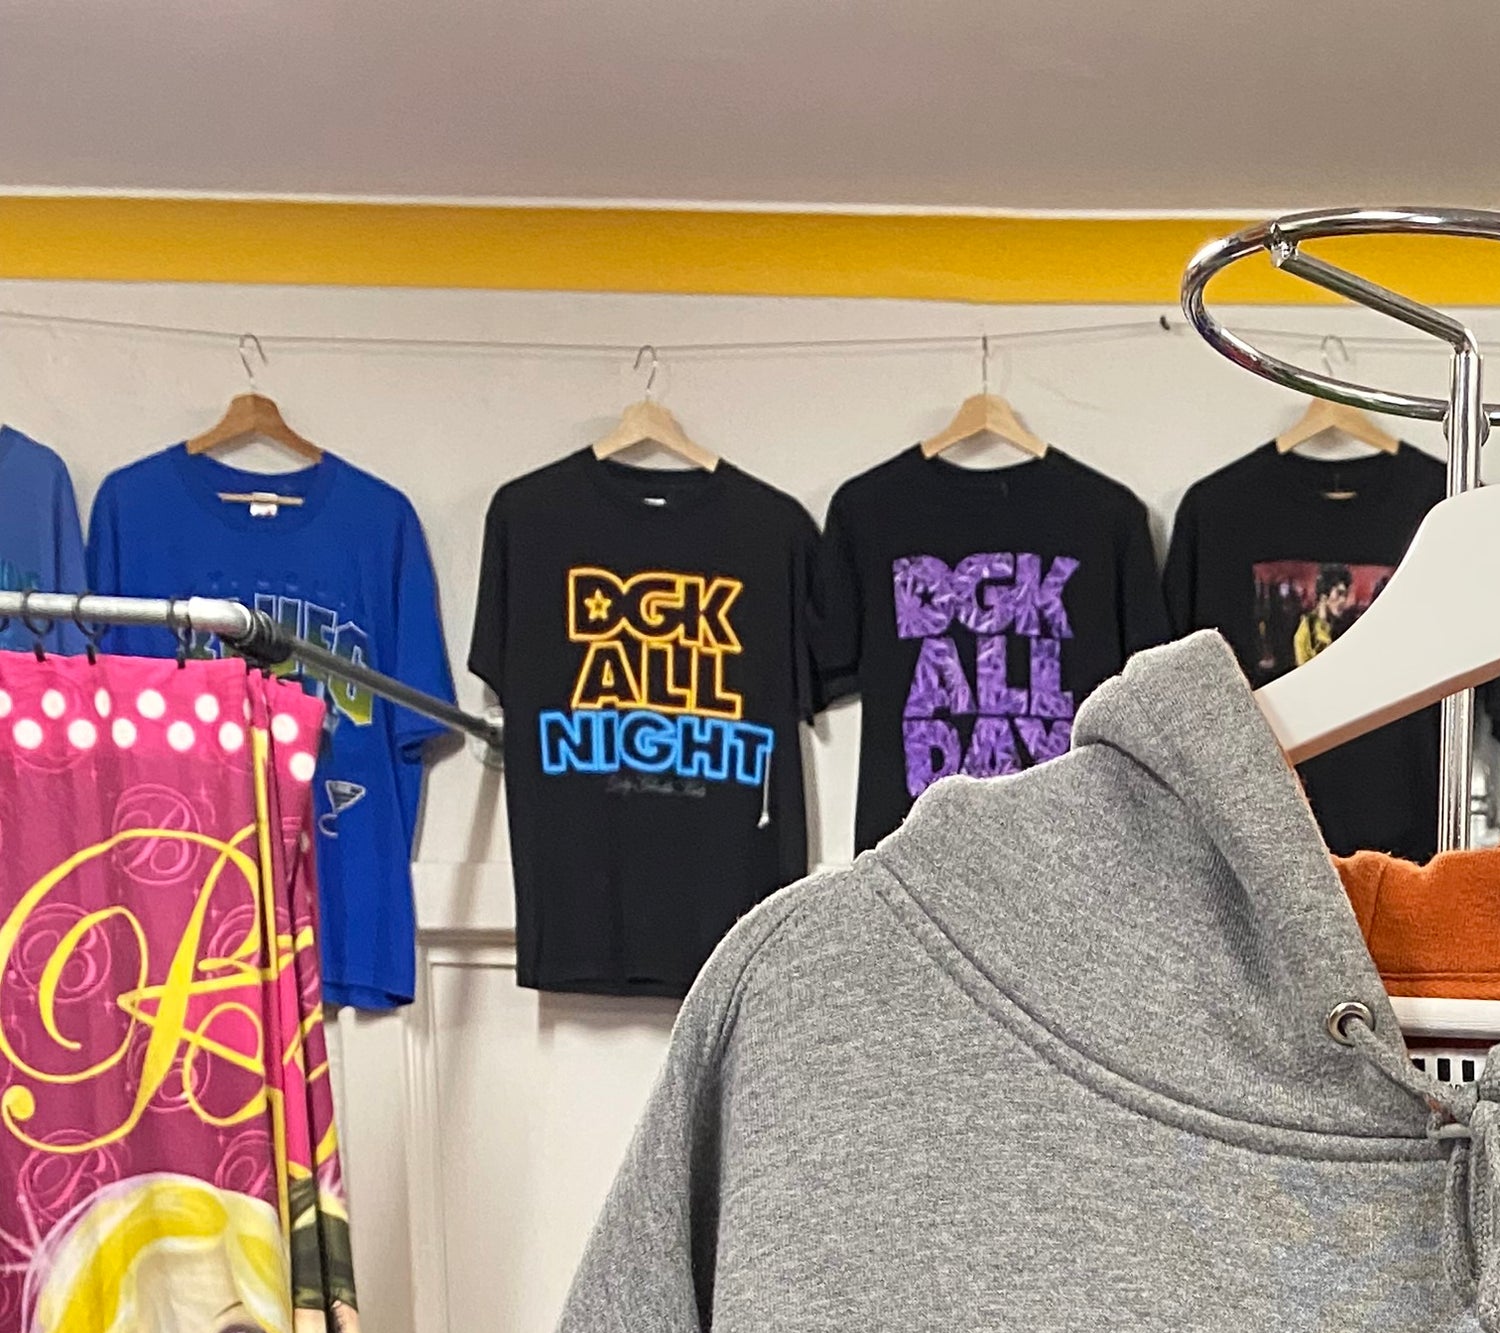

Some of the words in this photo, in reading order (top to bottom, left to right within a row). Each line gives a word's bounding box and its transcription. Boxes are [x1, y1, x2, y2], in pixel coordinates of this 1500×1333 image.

[568, 567, 743, 654] DGK
[893, 552, 1080, 639] DGK
[571, 640, 741, 720] ALL
[903, 634, 1073, 717] ALL
[539, 710, 774, 786] NIGHT
